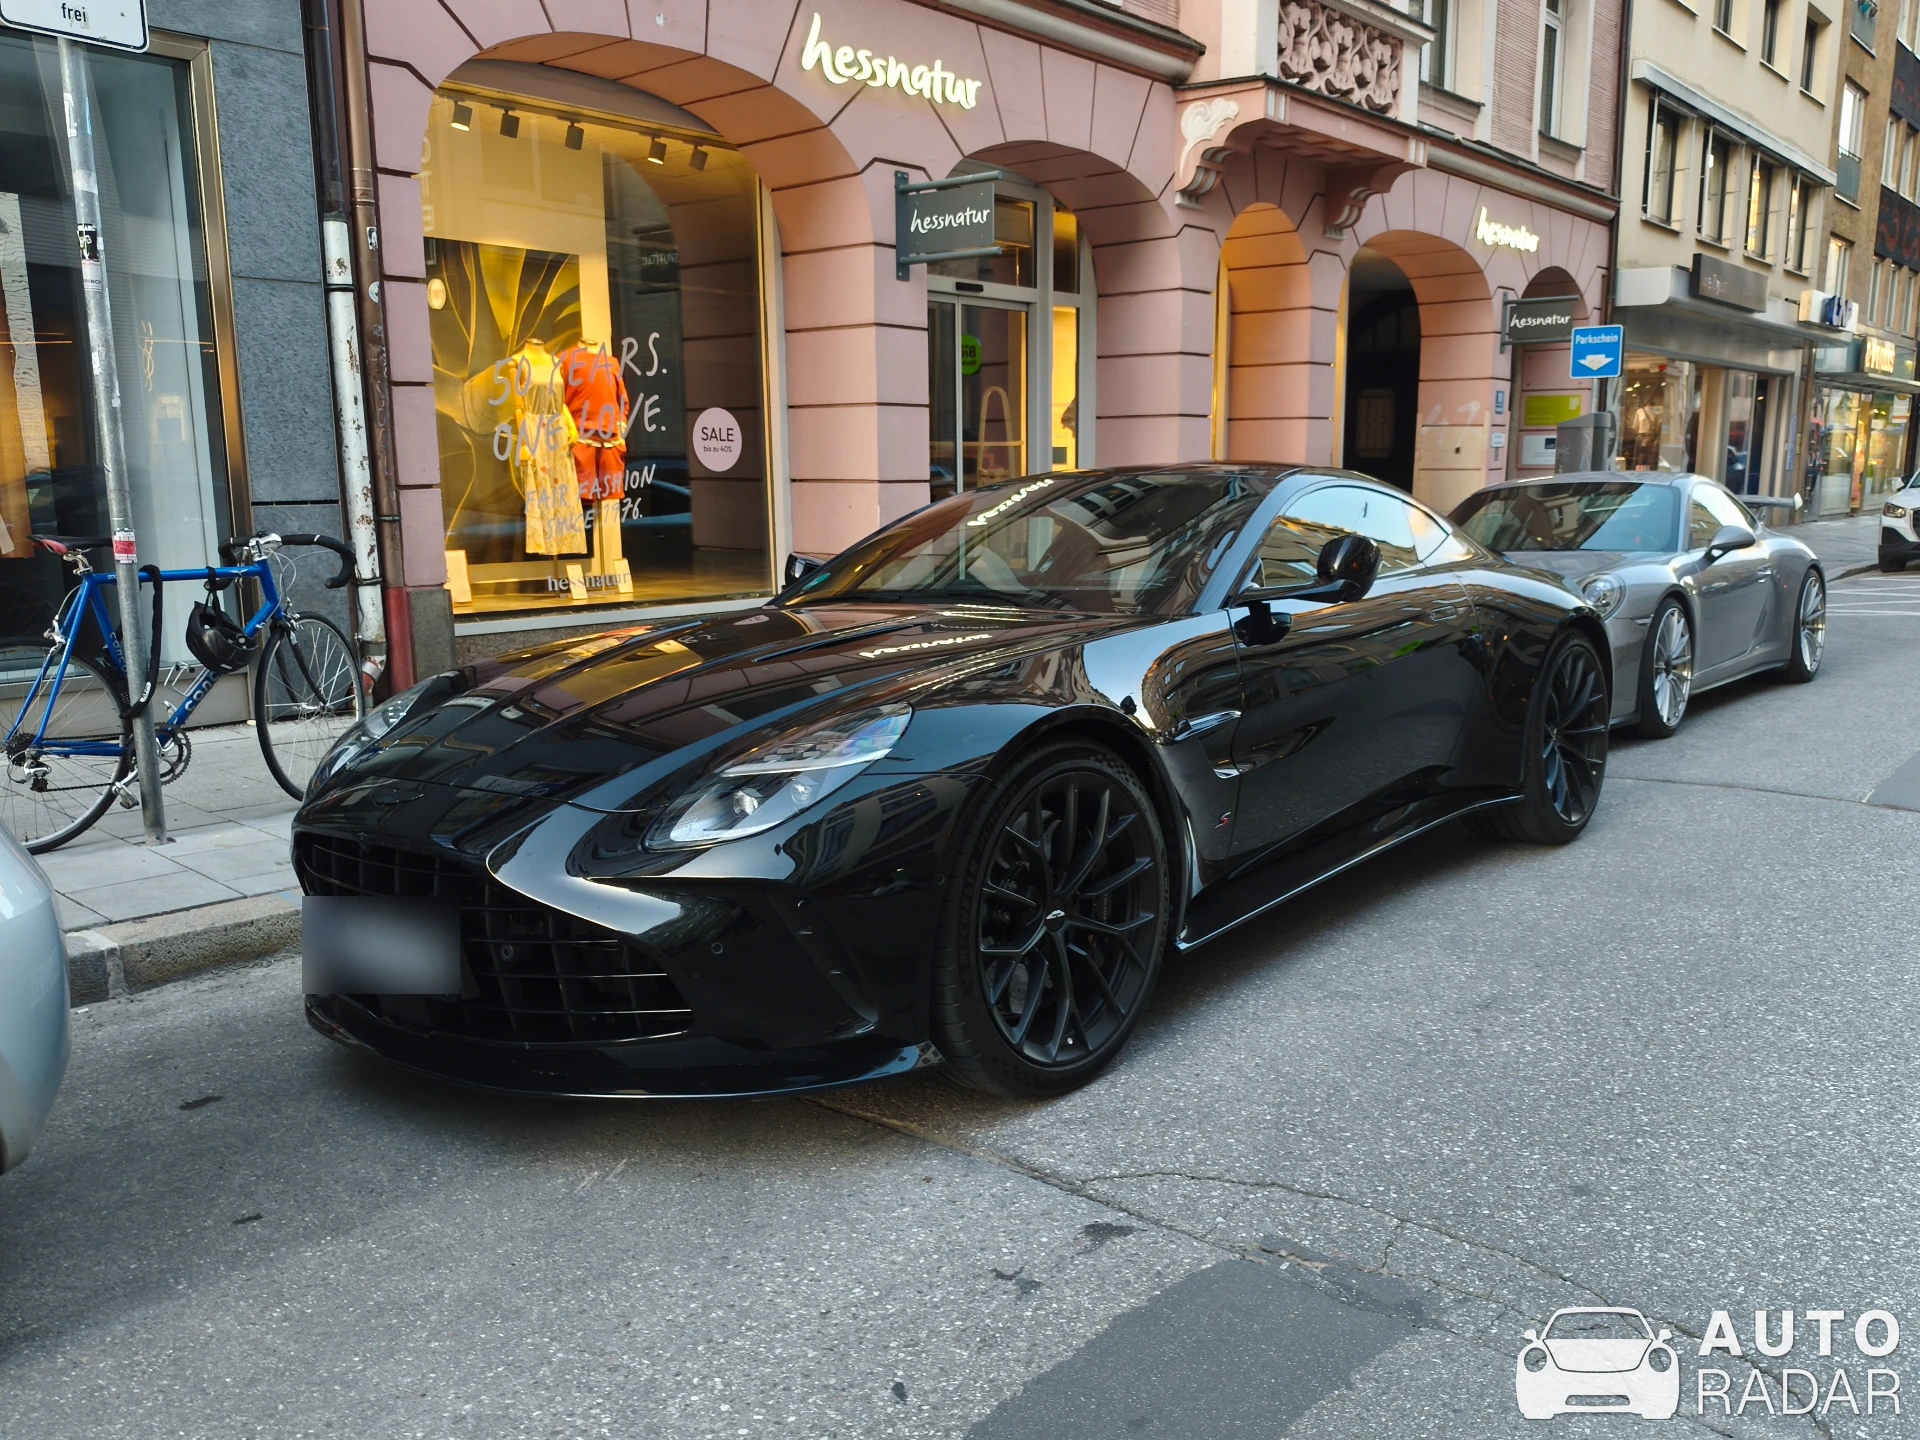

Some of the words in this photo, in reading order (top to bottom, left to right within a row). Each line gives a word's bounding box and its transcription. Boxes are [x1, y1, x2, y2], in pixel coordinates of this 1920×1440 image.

[61, 3, 87, 23] frei
[801, 12, 982, 110] hessnatur
[910, 206, 991, 234] hessnatur
[1476, 206, 1540, 252] hessnatur
[1510, 313, 1571, 328] hessnatur
[1575, 333, 1619, 345] Parkschein
[488, 354, 532, 406] 50
[548, 332, 668, 396] YEARS.
[493, 412, 563, 467] ONE
[579, 393, 667, 440] LOVE.
[701, 426, 735, 442] SALE
[720, 445, 733, 453] 40%
[524, 484, 569, 515] FAIR
[578, 464, 657, 500] FASHION
[545, 509, 596, 541] SINCE
[602, 497, 643, 524] 1976.
[547, 572, 630, 592] hessnatur
